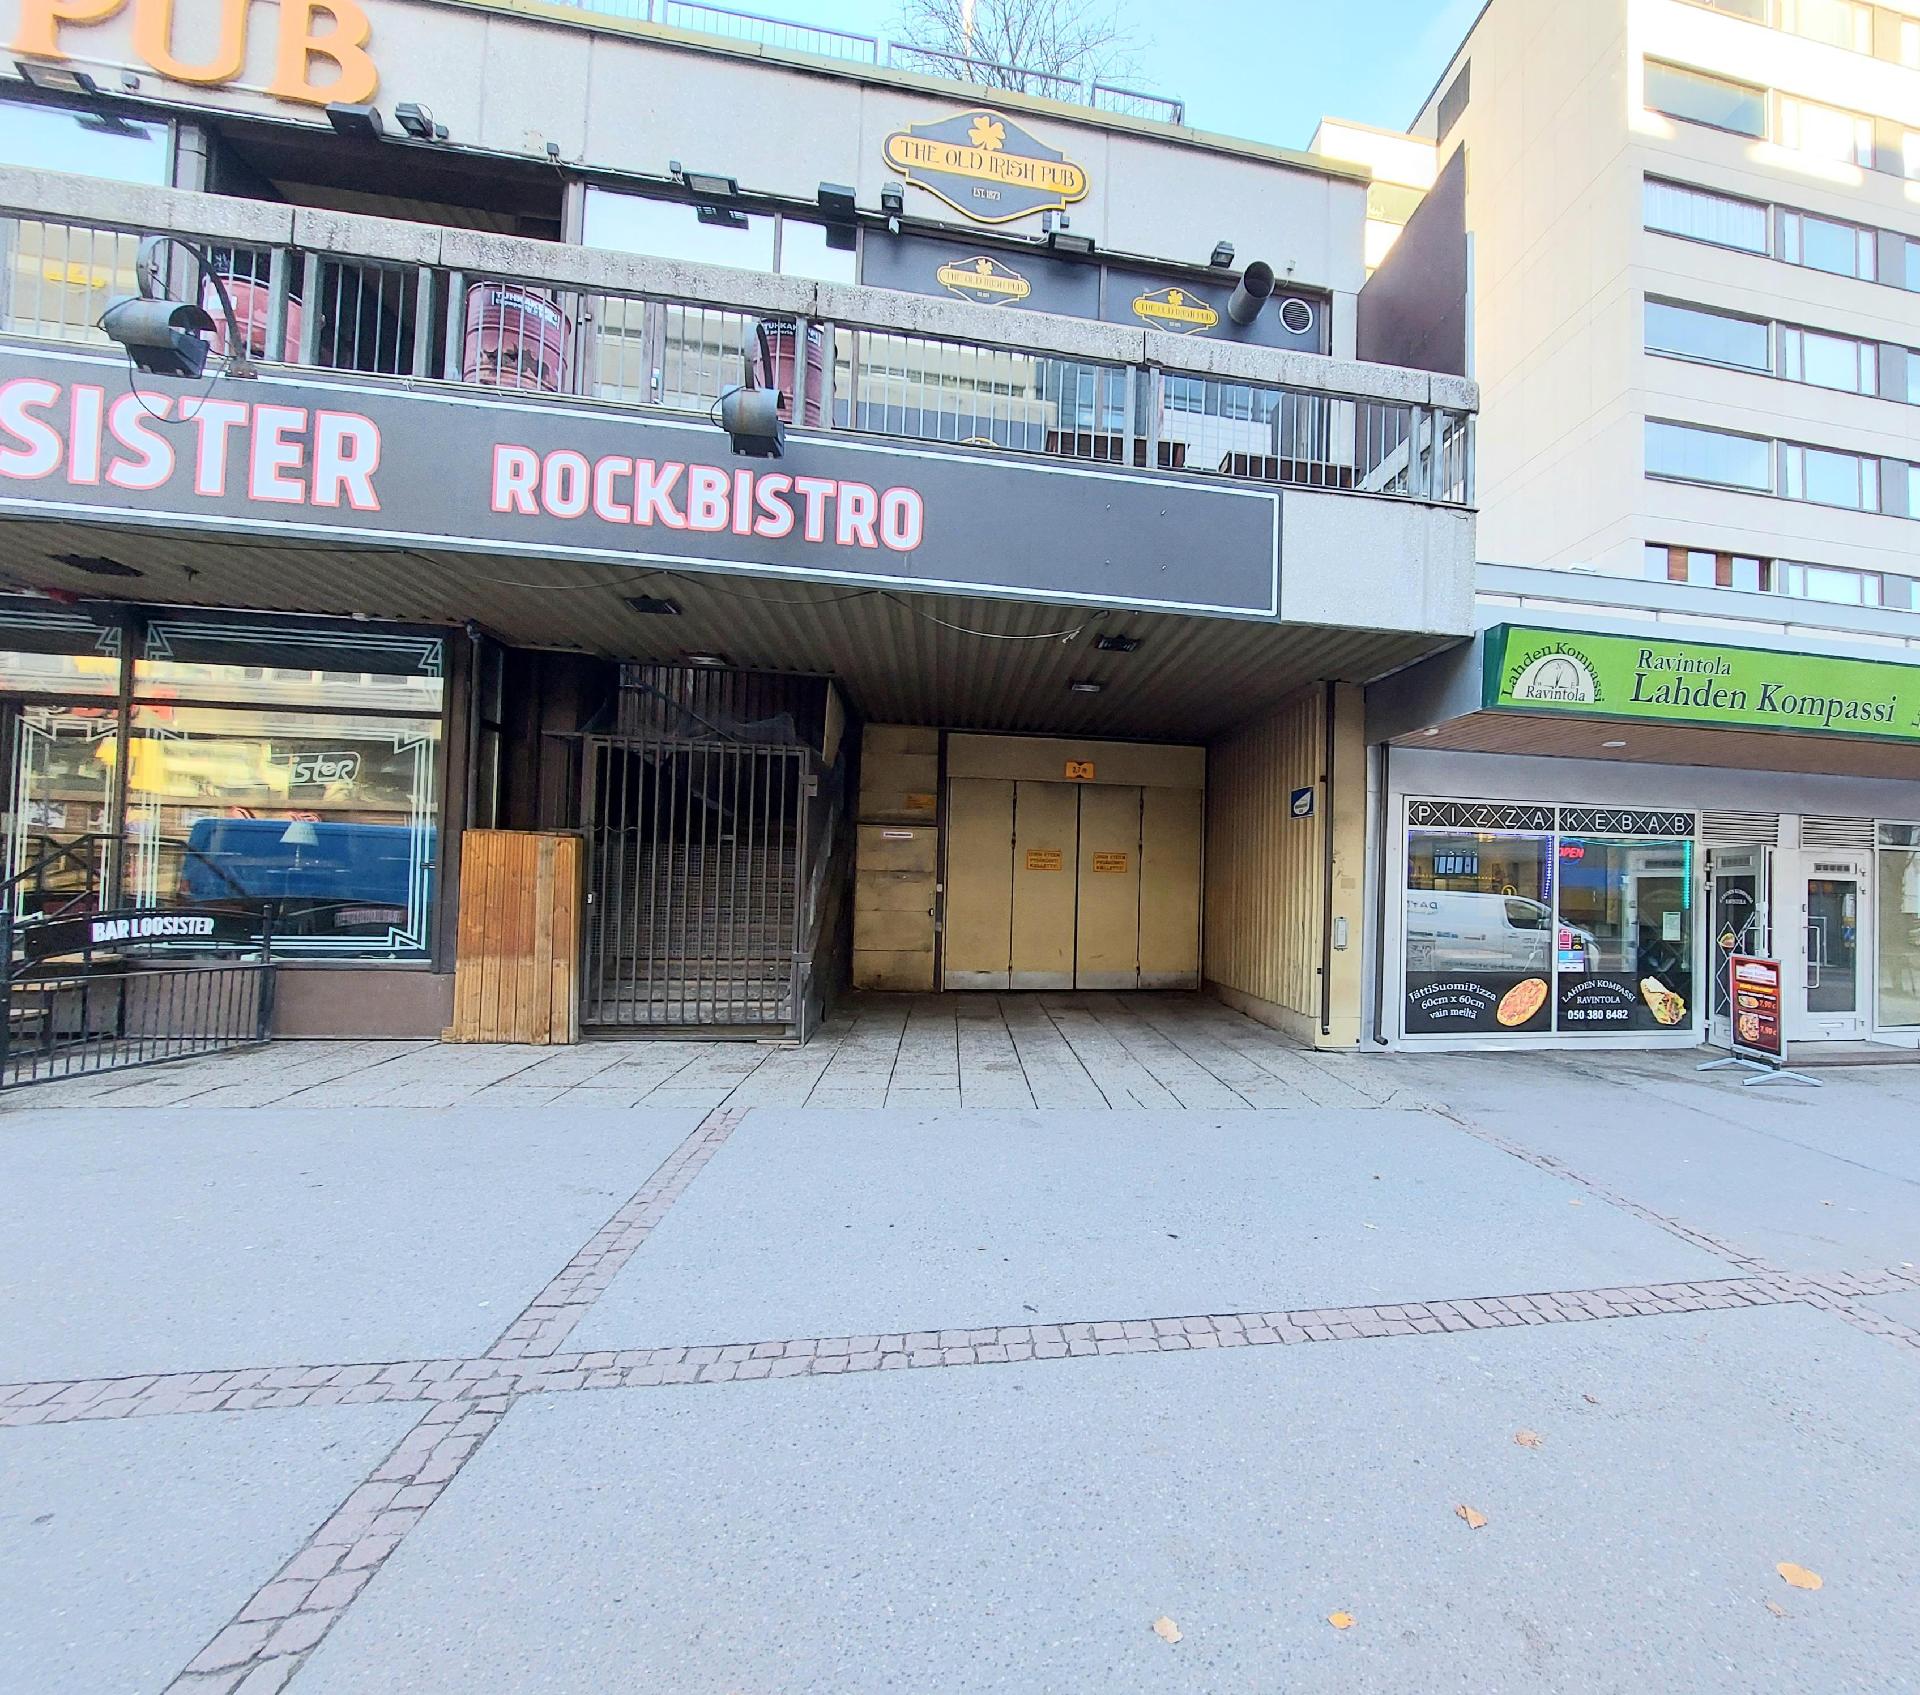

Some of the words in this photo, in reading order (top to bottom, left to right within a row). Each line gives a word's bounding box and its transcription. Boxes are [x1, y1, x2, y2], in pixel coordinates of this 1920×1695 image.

[901, 139, 938, 164] THE
[945, 149, 983, 171] OLD
[989, 155, 1035, 183] IRISH
[1041, 166, 1075, 188] PUB
[491, 443, 924, 552] ROCKBISTRO
[1501, 645, 1552, 698] Lahden
[1553, 642, 1605, 702] Kompassi
[1637, 649, 1731, 675] Ravintola
[1526, 685, 1586, 702] Ravintola
[1629, 672, 1748, 710] Lahden
[1756, 682, 1897, 727] Kompassi
[1418, 805, 1545, 828] PIZZA
[1566, 812, 1686, 832] KEBAB
[92, 919, 130, 943] BAR
[131, 916, 215, 937] LOOSISTER
[1421, 996, 1448, 1010] 60cm
[1459, 995, 1485, 1010] 60cm
[1561, 979, 1596, 1003] LAHDEN
[1597, 979, 1637, 1002] KOMPASSI
[1576, 996, 1621, 1004] RAVINTOLA
[1429, 1008, 1448, 1019] vain
[1567, 1009, 1585, 1020] 050
[1587, 1009, 1604, 1020] 380
[1605, 1009, 1629, 1020] 8482
